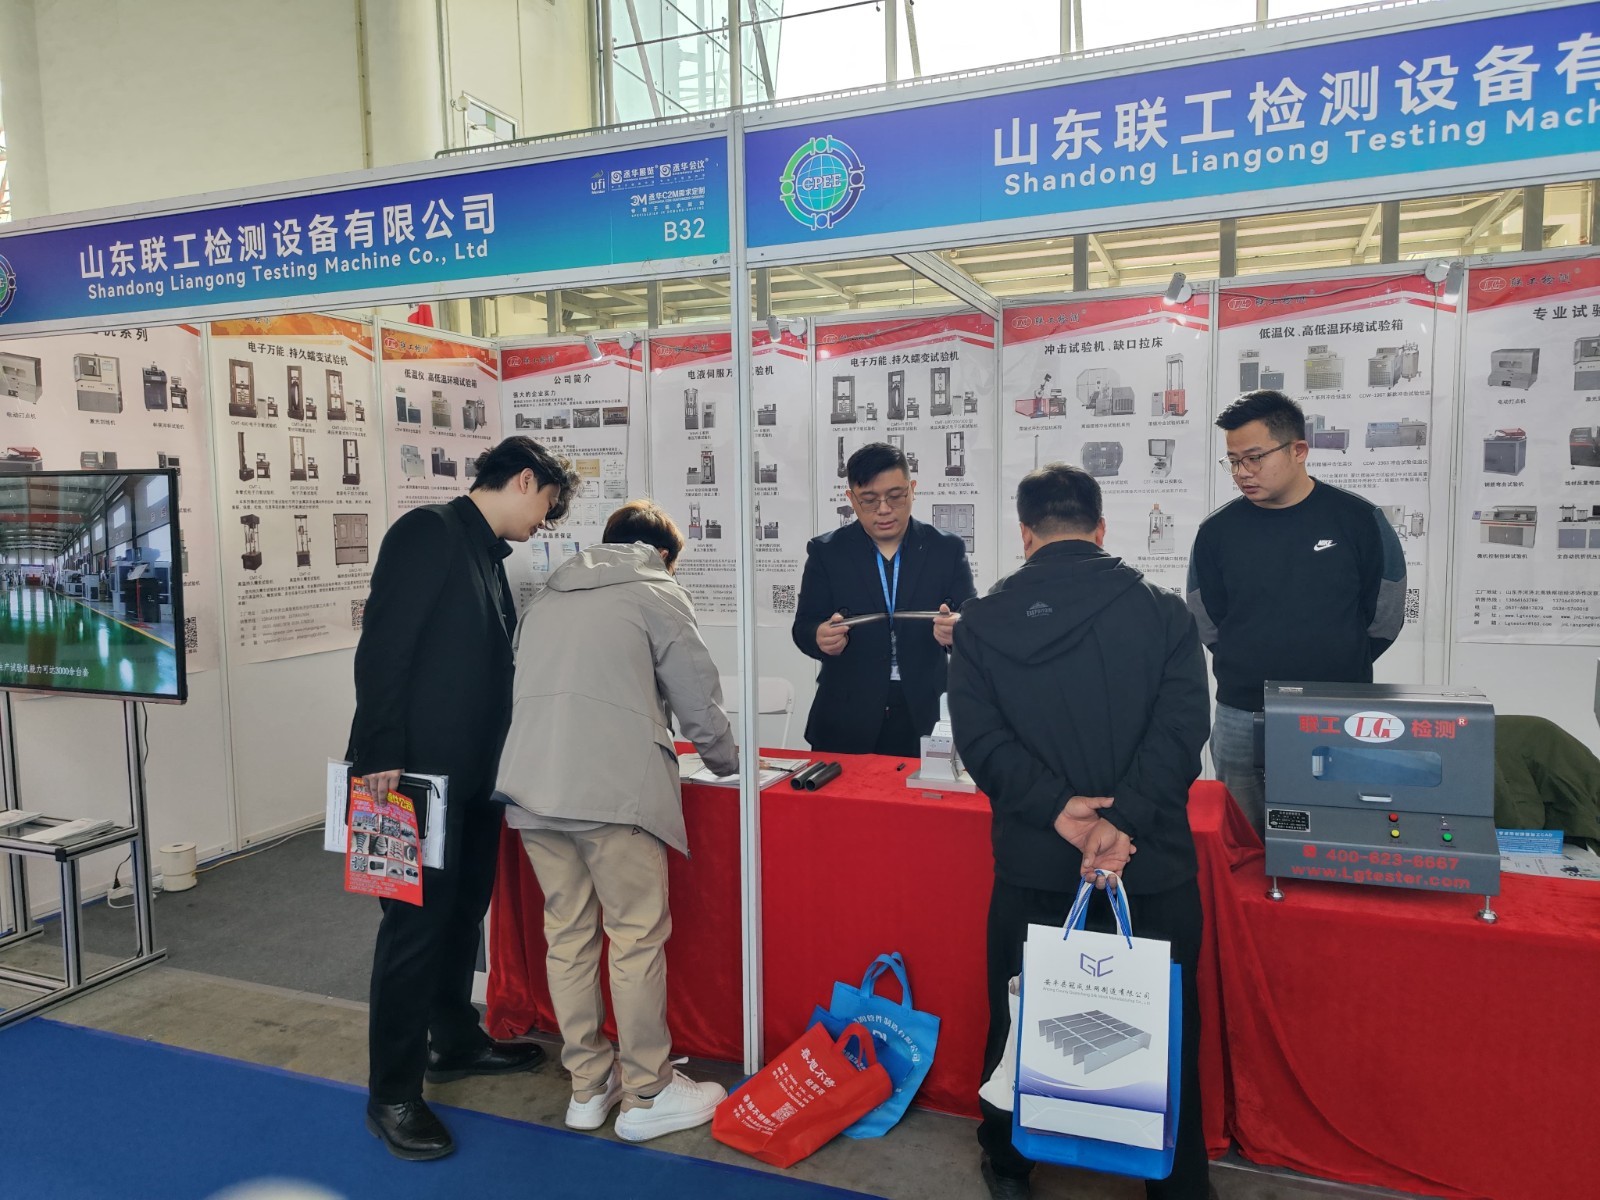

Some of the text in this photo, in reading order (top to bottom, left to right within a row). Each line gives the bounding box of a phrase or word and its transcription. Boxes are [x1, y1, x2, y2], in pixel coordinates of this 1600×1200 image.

[1004, 162, 1157, 196] Shandong
[1172, 139, 1329, 173] Liangong
[1345, 119, 1486, 153] Testing
[591, 178, 606, 191] ufi
[802, 173, 842, 191] CPEE
[80, 193, 495, 279] 山东联工检测设备有限公司
[664, 217, 706, 242] B32
[88, 239, 488, 299] Shandong Liangong Testing Machine Co., Ltd
[1258, 318, 1404, 340] 低温仪、高低温环境试验箱
[1044, 336, 1164, 355] 冲击试验机、缺口拉床
[850, 350, 960, 367] 电子万能、持久蠕变试验机
[554, 373, 592, 385] 公司简介
[1298, 714, 1341, 734] 联工
[1352, 716, 1393, 739] LG
[1410, 719, 1457, 740] 检测
[1290, 864, 1471, 890] www.Lgtester.com
